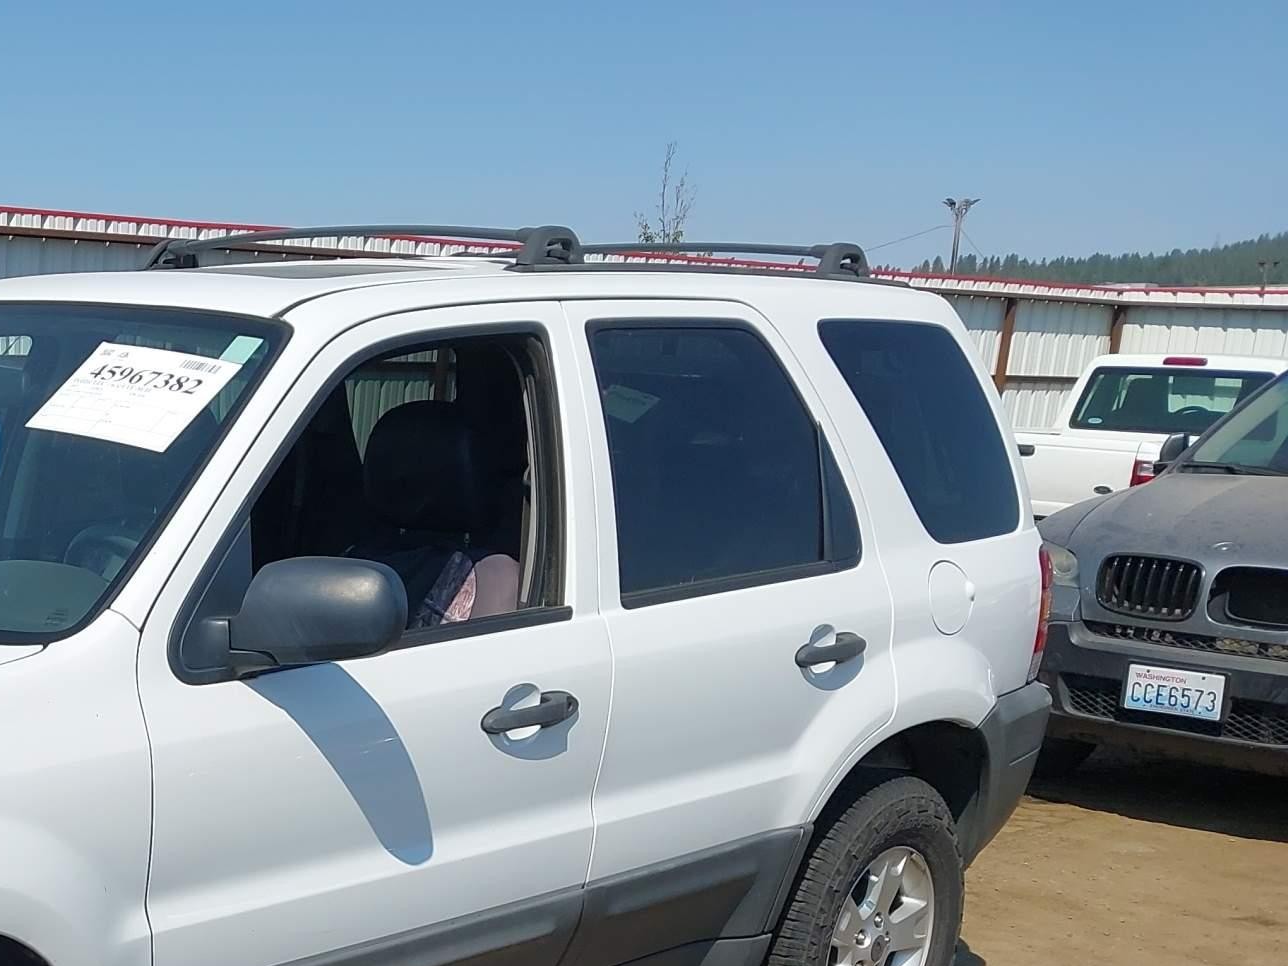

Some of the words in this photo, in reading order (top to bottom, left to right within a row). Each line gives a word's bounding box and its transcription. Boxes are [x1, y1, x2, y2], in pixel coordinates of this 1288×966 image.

[89, 363, 204, 395] 45967382
[1135, 672, 1187, 684] WASHINGTON
[1130, 682, 1217, 712] CCE6573
